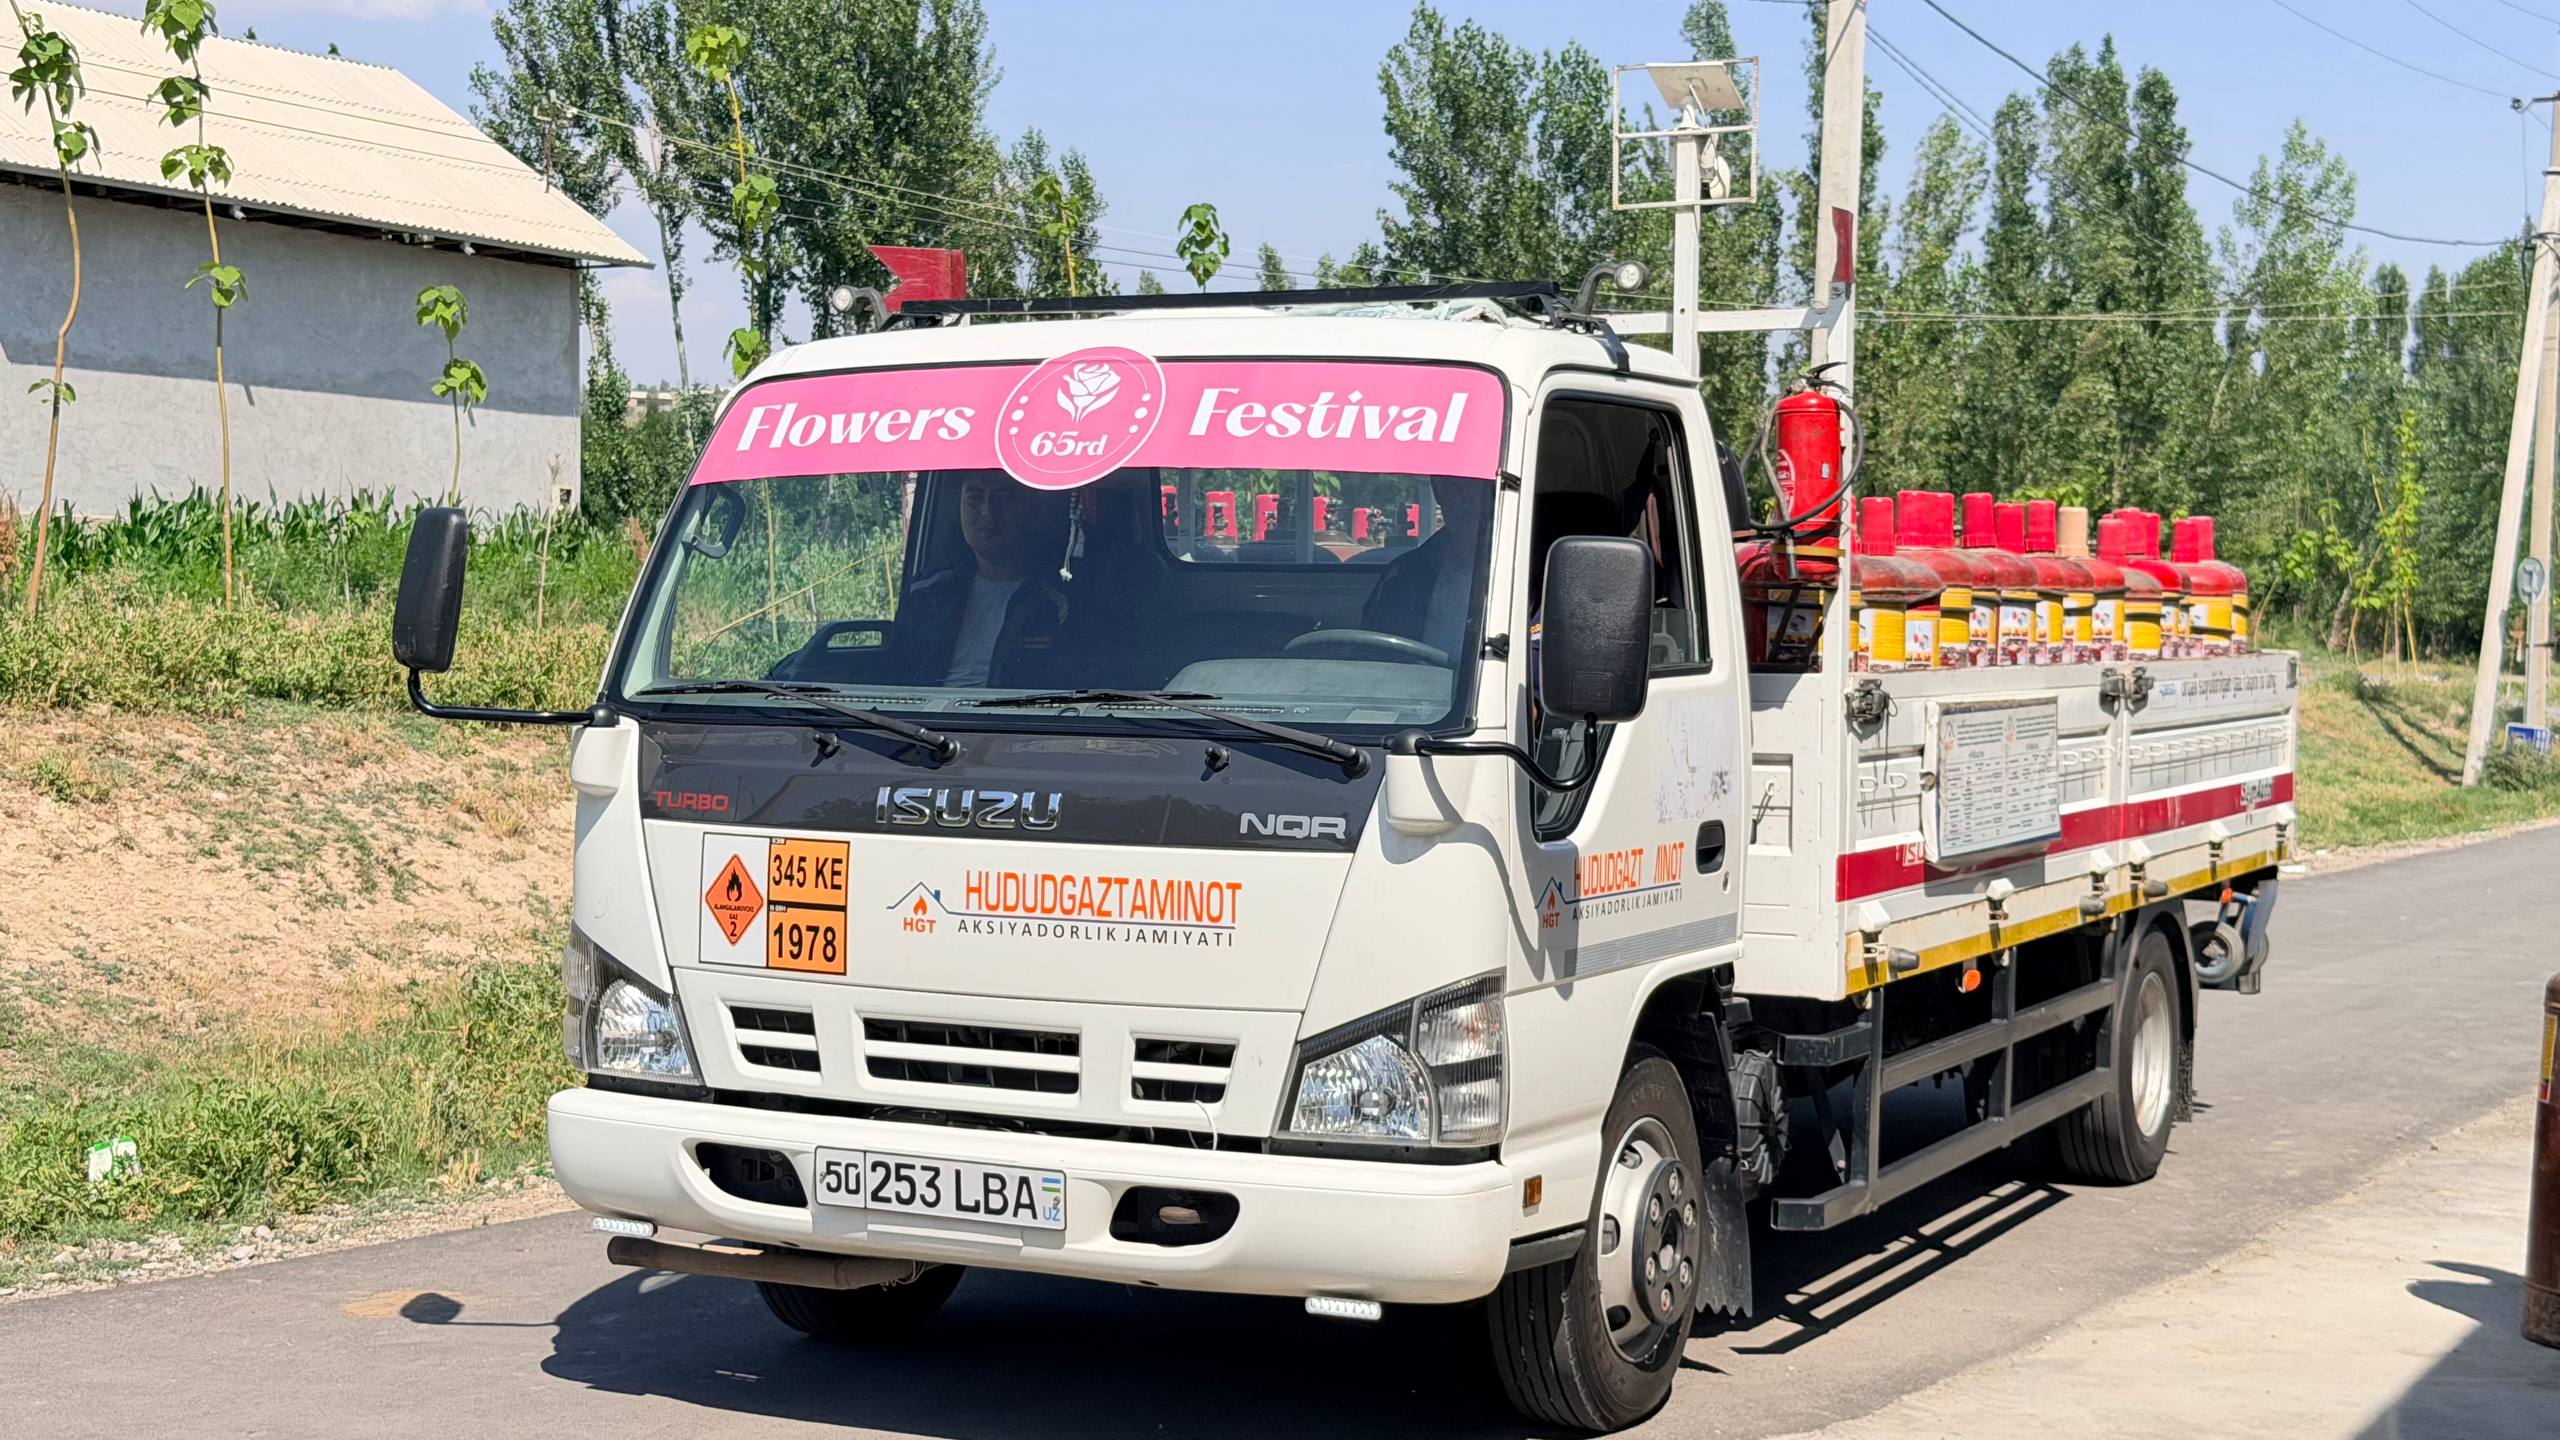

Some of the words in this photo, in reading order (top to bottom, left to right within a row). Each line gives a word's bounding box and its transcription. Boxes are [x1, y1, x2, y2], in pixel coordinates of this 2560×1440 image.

[736, 401, 976, 452] Flowers
[1188, 387, 1470, 443] Festival
[1029, 430, 1108, 457] 65rd
[653, 790, 730, 813] TURBO
[875, 786, 1063, 831] ISUZU
[1240, 812, 1347, 839] NQR
[772, 854, 807, 888] 345
[814, 856, 843, 890] KE
[965, 869, 1243, 925] HUDUDGAZTAMINOT
[1572, 896, 1640, 921] AKSIYADORLIK
[1642, 887, 1683, 909] JAMIYATI
[729, 921, 737, 937] 2
[903, 917, 936, 934] HGT
[957, 919, 1117, 942] AKSIYADORLIK
[1123, 927, 1233, 947] JAMIYATI
[1542, 912, 1560, 928] HGT
[773, 922, 837, 963] 1978
[825, 1160, 861, 1195] 50
[870, 1160, 942, 1208] 253
[954, 1168, 1038, 1220] LBA
[1042, 1205, 1061, 1222] UZ
